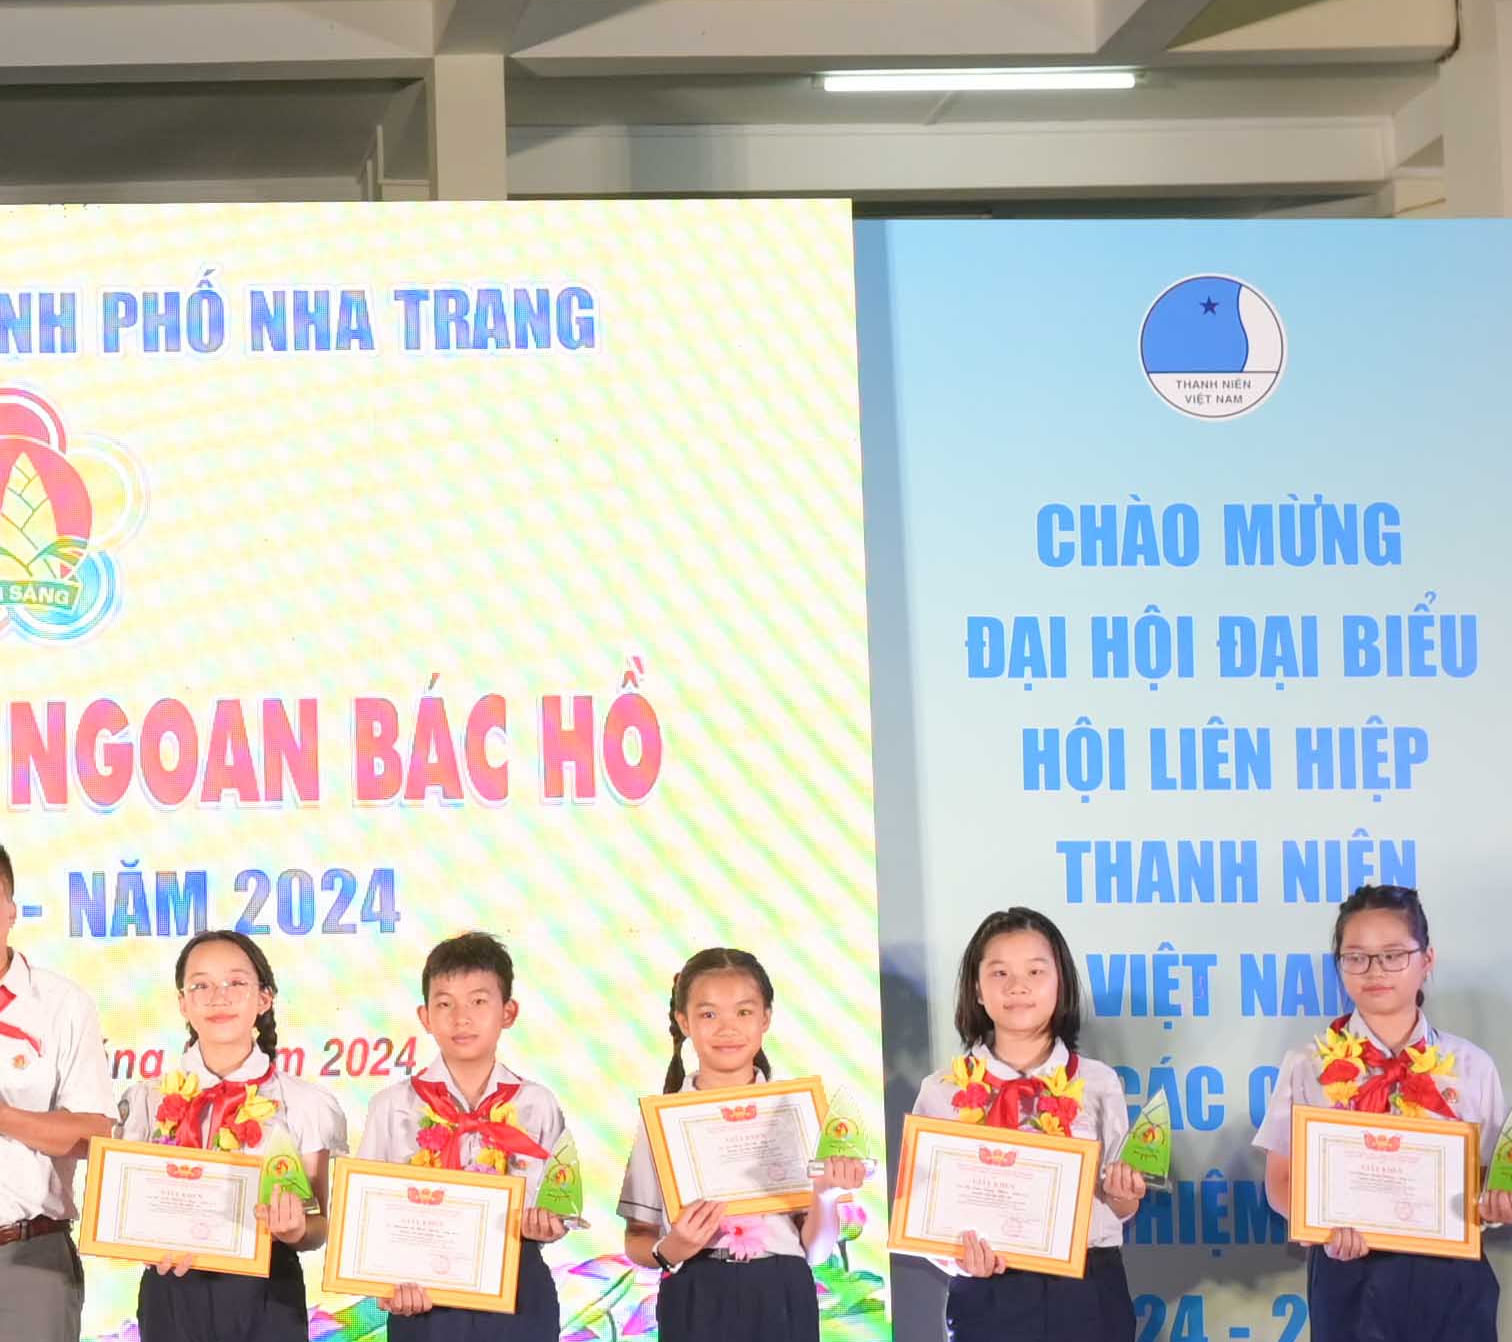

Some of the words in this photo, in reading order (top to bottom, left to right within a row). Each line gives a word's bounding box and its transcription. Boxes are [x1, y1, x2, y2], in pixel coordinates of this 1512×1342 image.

[102, 268, 223, 356] PHỐ
[251, 287, 375, 353] NHA
[393, 286, 598, 353] TRANG
[1176, 380, 1217, 390] THANH
[1185, 392, 1212, 407] VIỆT
[1216, 394, 1243, 405] NAM
[1037, 493, 1201, 568] CHÀO
[1224, 493, 1402, 567] MỪNG
[965, 615, 1066, 691] ĐẠI
[1091, 604, 1194, 691] HỘI
[1217, 615, 1318, 691] ĐẠI
[1343, 590, 1478, 679] BIỂU
[8, 694, 325, 807] NGOAN
[354, 674, 509, 805] BÁC
[542, 657, 662, 803] HỒ
[1022, 716, 1125, 803] HỘI
[1150, 716, 1271, 790] LIÊN
[1296, 714, 1429, 803] HIỆP
[69, 858, 208, 937] NĂM
[233, 867, 401, 936] 2024
[1056, 840, 1258, 904] THANH
[1282, 829, 1417, 904] NIÊN
[1086, 942, 1217, 1029] VIỆT
[320, 1037, 417, 1076] 2024
[1126, 1169, 1288, 1257] HIỆM
